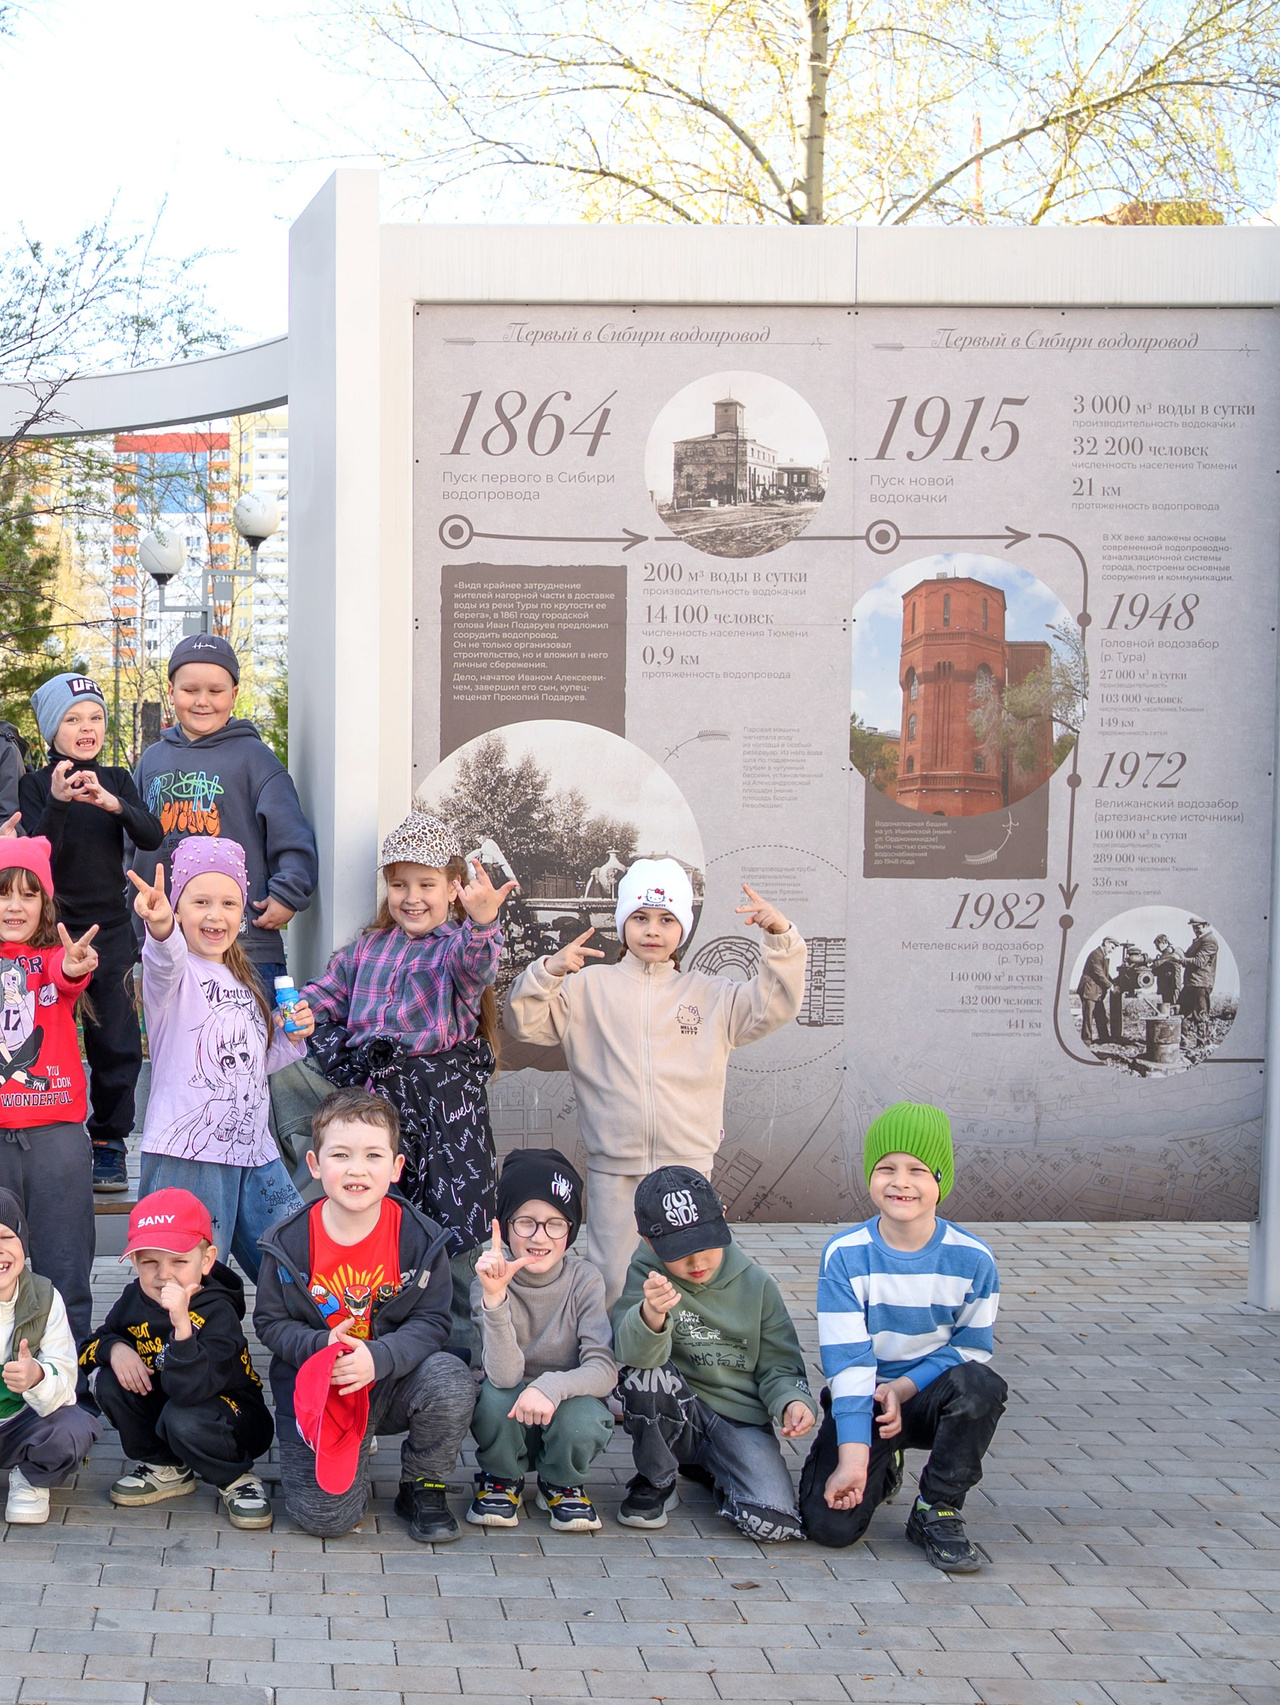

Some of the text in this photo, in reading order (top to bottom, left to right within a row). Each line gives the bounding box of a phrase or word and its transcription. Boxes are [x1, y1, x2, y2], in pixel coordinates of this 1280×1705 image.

[502, 321, 771, 347] Первый в Сибири водопровод
[931, 327, 1199, 353] Первый в Сибири водопровод
[1073, 395, 1085, 415] 3
[1091, 395, 1133, 415] 000
[1158, 405, 1195, 417] воды
[1201, 405, 1209, 415] в
[1213, 405, 1255, 420] сутки
[439, 389, 618, 458] 1864
[864, 394, 1030, 462] 1915
[1072, 420, 1236, 429] производительность водокачки
[1073, 436, 1209, 457] 32 200 человек
[1071, 461, 1239, 470] численность населения Тюмени
[443, 471, 615, 486] Пуск первого в Сибири
[870, 474, 954, 489] Пуск новой
[1072, 477, 1121, 497] 21 км
[442, 491, 540, 503] водопровода
[870, 494, 947, 504] водокачки
[1071, 502, 1220, 512] протяженность водопровода
[643, 563, 683, 582] 200
[710, 572, 748, 585] воды
[753, 572, 761, 582] в
[765, 572, 807, 588] сутки
[454, 581, 582, 591] «Видя крайнее затруднение
[454, 591, 493, 599] жителей
[495, 591, 538, 601] нагорной
[643, 588, 806, 597] производительность водокачки
[454, 603, 477, 612] воды
[516, 601, 539, 611] Туры
[554, 603, 594, 611] крутости
[1100, 592, 1200, 631] 1948
[453, 611, 492, 620] берега»,
[500, 611, 518, 619] 1861
[520, 613, 540, 621] году
[542, 611, 589, 621] городской
[645, 605, 774, 624] 14 100 человек
[486, 621, 509, 629] Иван
[511, 621, 555, 631] Подаруев
[453, 632, 559, 640] соорудить водопровод.
[710, 630, 765, 638] населения
[767, 629, 808, 638] Тюмени
[453, 641, 467, 649] Он
[513, 642, 572, 650] организовал
[1101, 638, 1220, 651] Головной водозабор
[453, 652, 521, 660] строительство,
[642, 646, 699, 667] 0,9 км
[1100, 652, 1146, 664] (р. Тура)
[489, 660, 548, 670] сбережения.
[452, 673, 478, 682] Дело,
[518, 673, 553, 681] Иваном
[554, 674, 606, 682] Алексееви-
[642, 671, 791, 680] протяженность водопровода
[474, 684, 520, 692] завершил
[560, 685, 590, 693] купец-
[453, 693, 587, 703] меценат Прокопий Подаруев.
[1092, 751, 1187, 789] 1972
[1095, 798, 1239, 811] Велижанский водозабор
[1094, 812, 1244, 824] (артезианские источники)
[945, 892, 1045, 930] 1982
[901, 941, 1045, 953] Метелевский водозабор
[998, 954, 1044, 966] (р. Тура)
[4, 1009, 20, 1031] 17
[46, 1065, 60, 1077] YOU
[51, 1077, 72, 1089] LOOK
[0, 1091, 73, 1107] WONDERFUL
[662, 1189, 693, 1211] OUT
[665, 1203, 699, 1227] SIDE
[137, 1214, 176, 1229] SANY
